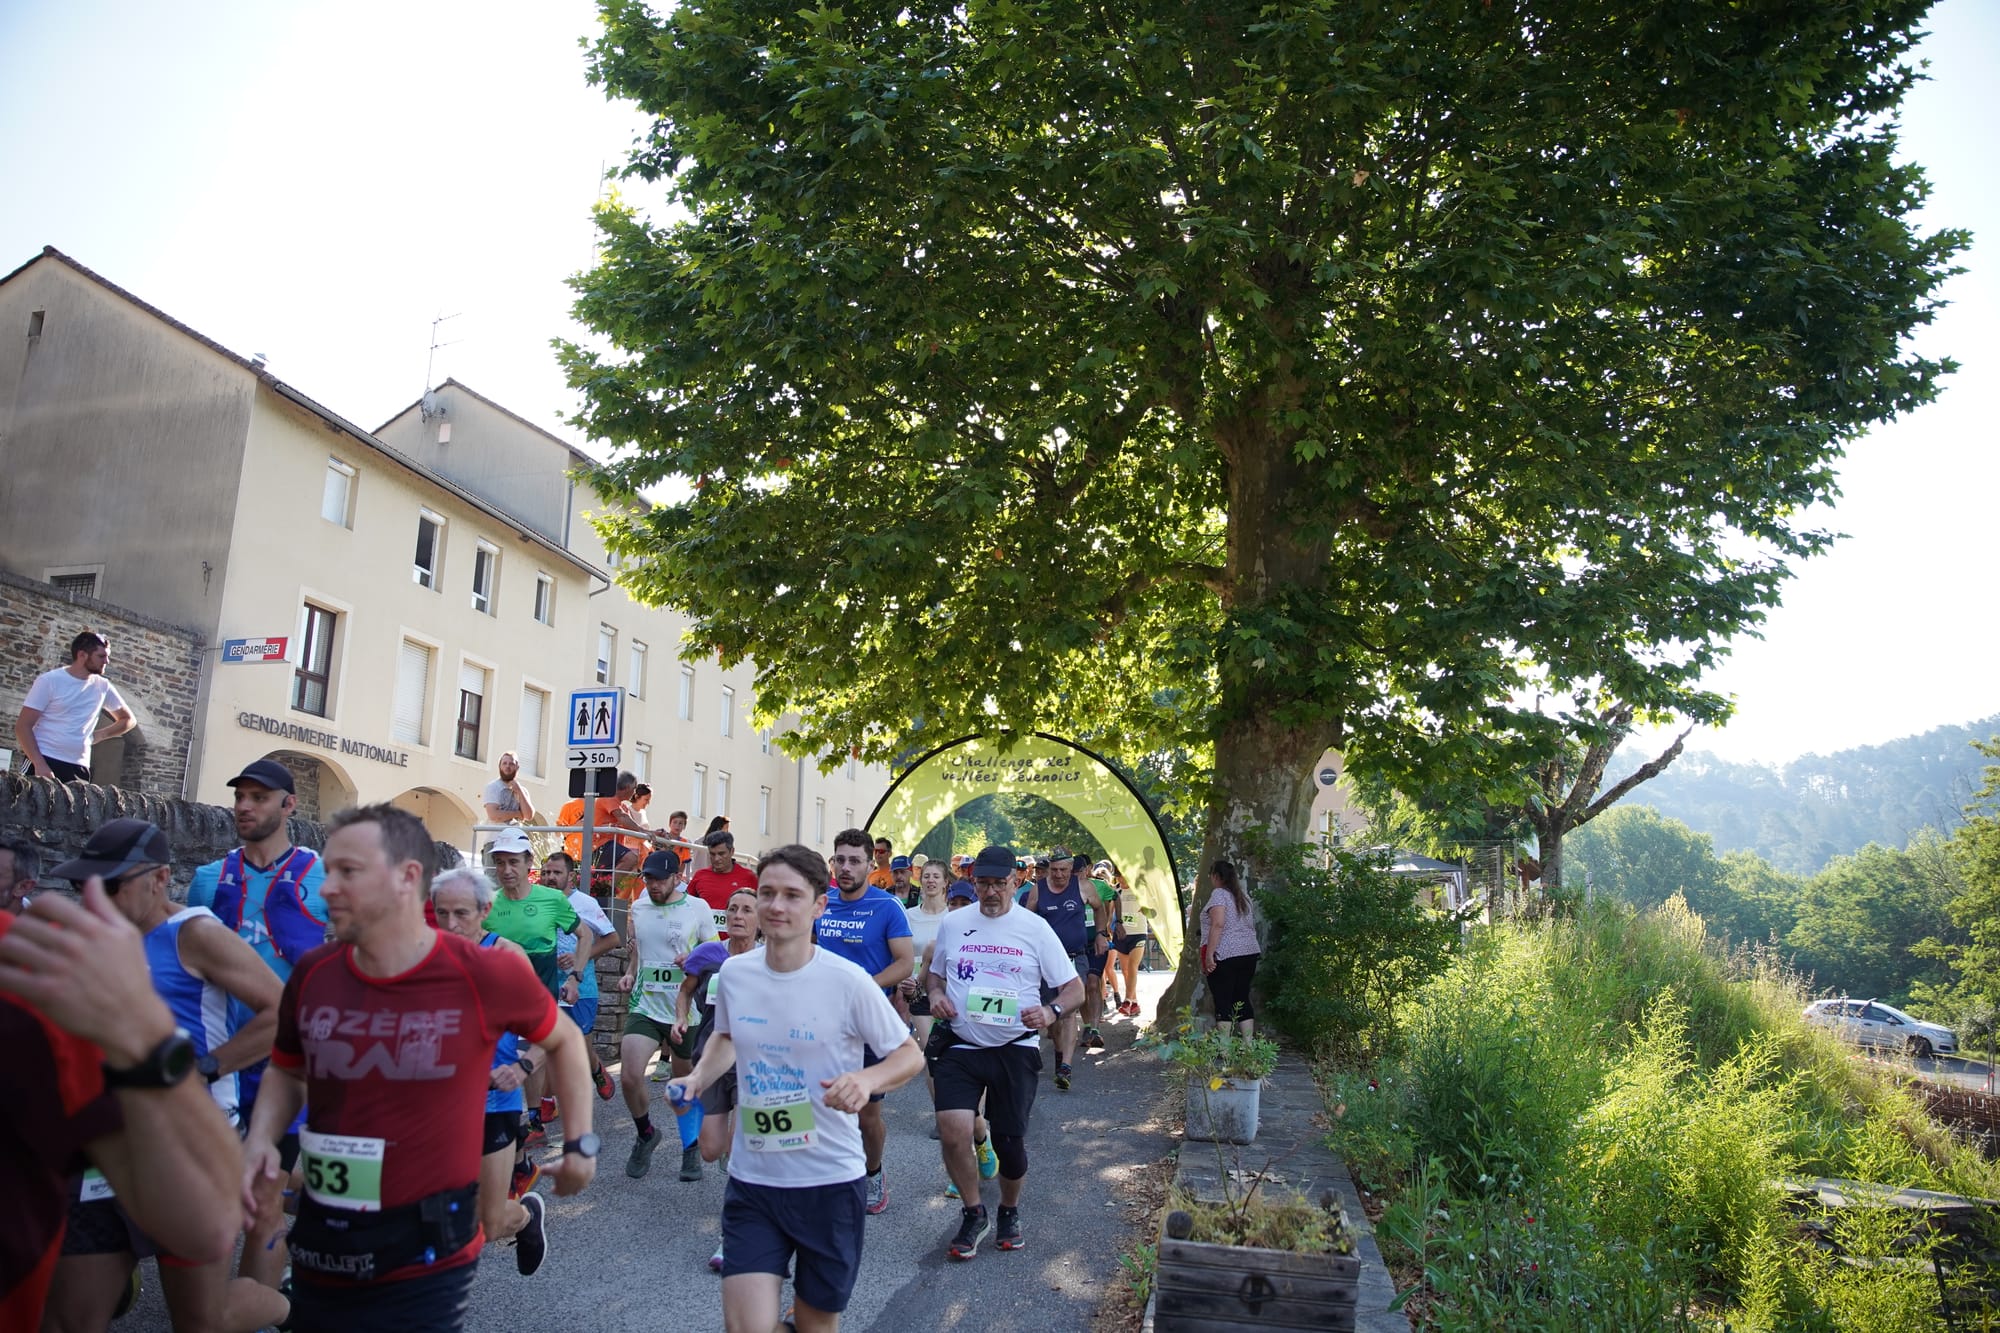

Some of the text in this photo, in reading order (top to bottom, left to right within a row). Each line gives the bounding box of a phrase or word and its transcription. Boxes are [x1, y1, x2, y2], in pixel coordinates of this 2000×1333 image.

[231, 644, 279, 656] GENDARMERIE
[237, 711, 408, 767] GENDARMERIE NATIONALE
[952, 756, 1071, 771] Challenge des
[942, 770, 998, 783] vallées
[821, 918, 866, 930] warsaw
[820, 928, 842, 938] runs
[959, 945, 1023, 956] MENDEKIDEN
[652, 968, 672, 982] 10
[981, 997, 1004, 1014] 71
[299, 1005, 463, 1037] LOZÈRE
[301, 1039, 457, 1081] TRAIL
[754, 1109, 793, 1135] 96
[307, 1156, 350, 1195] 53
